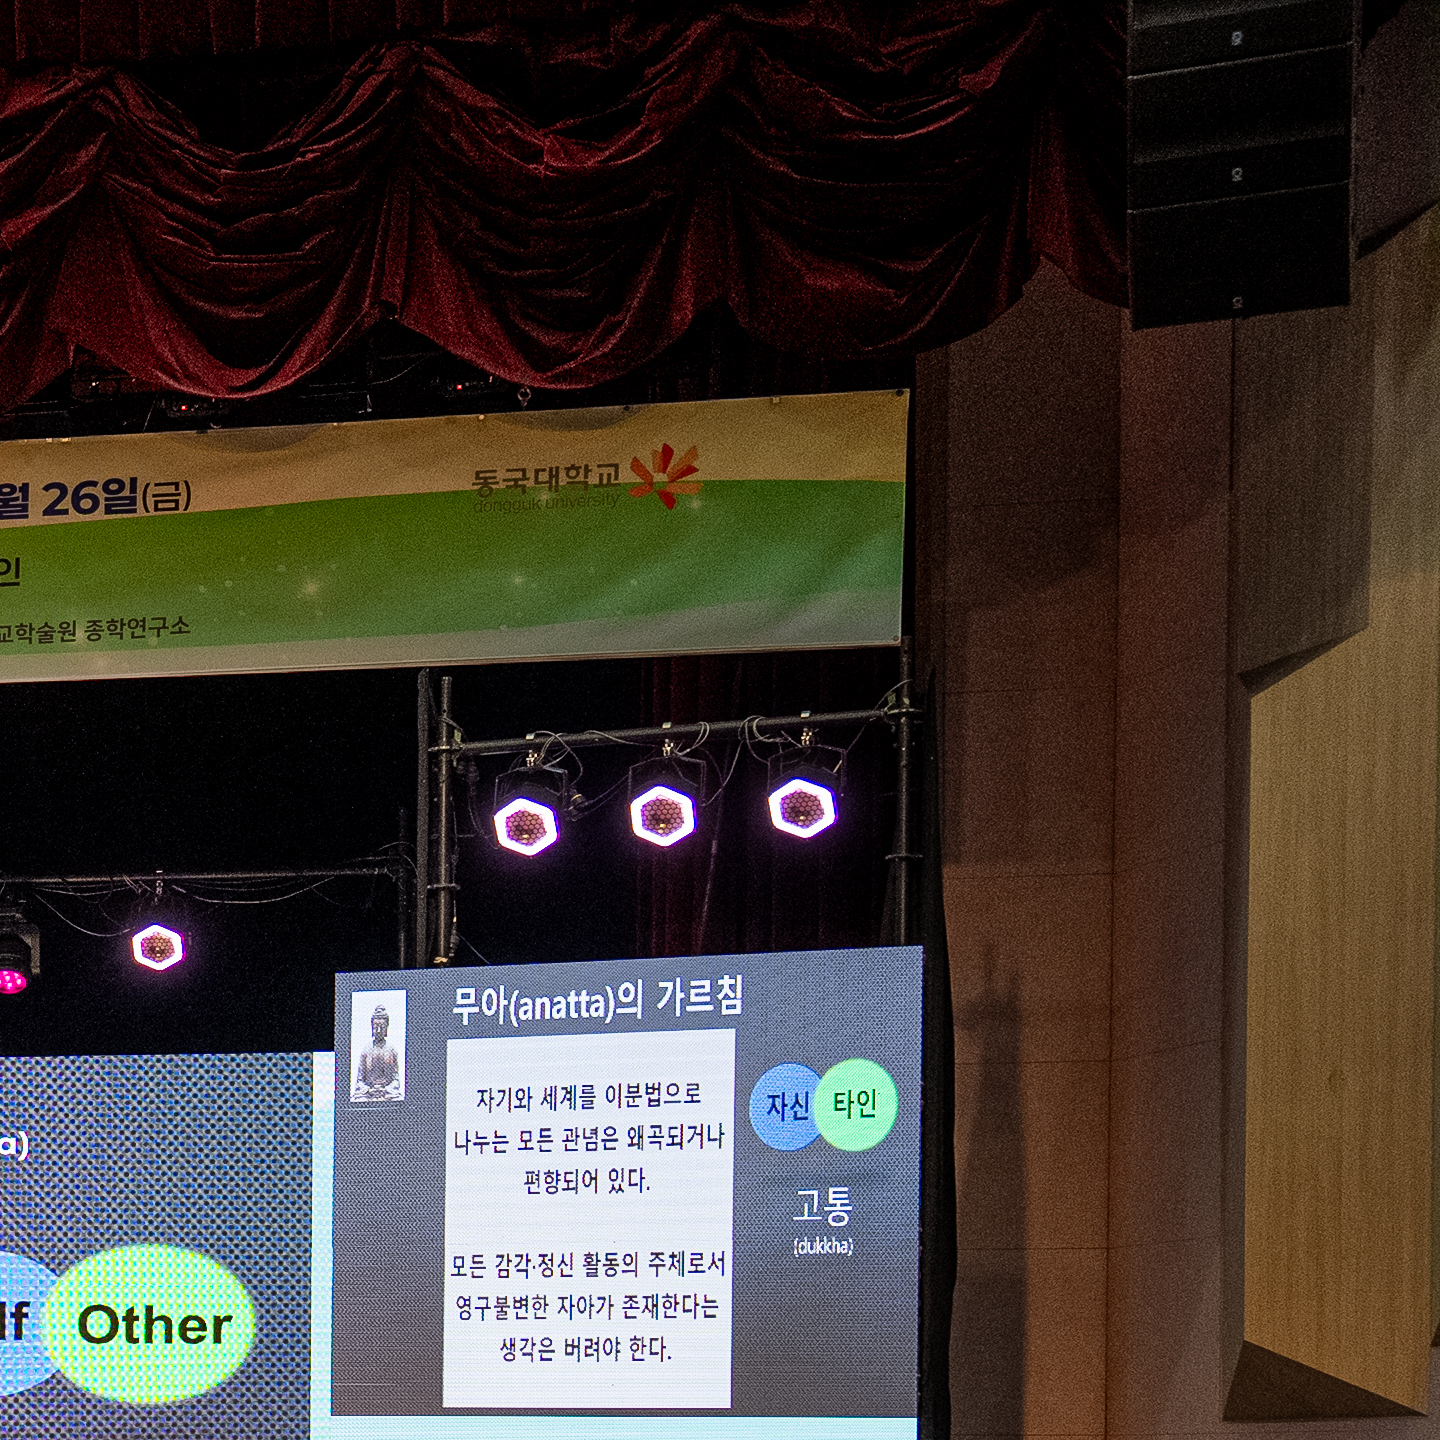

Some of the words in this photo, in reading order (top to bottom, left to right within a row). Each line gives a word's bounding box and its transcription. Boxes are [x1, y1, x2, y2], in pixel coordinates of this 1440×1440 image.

[472, 463, 620, 498] 동국대학교
[41, 476, 191, 517] 26일(금)
[84, 615, 191, 642] 종학연구소
[453, 979, 643, 1028] 무아(anatta)의
[657, 974, 742, 1017] 가르침
[477, 1086, 533, 1113] 자기와
[540, 1084, 596, 1111] 세계를
[606, 1082, 701, 1108] 이분법으로
[766, 1091, 809, 1122] 자신
[834, 1089, 876, 1119] 타인
[455, 1130, 509, 1155] 나누는
[517, 1128, 553, 1152] 모든
[562, 1126, 619, 1152] 관념은
[627, 1122, 725, 1151] 왜곡되거나
[524, 1168, 598, 1194] 편향되어
[608, 1167, 650, 1194] 있다.
[792, 1186, 853, 1227] 고통
[793, 1236, 854, 1257] (dukkha)
[451, 1254, 486, 1278] 모든
[495, 1252, 573, 1279] 감각·정신
[583, 1251, 638, 1278] 활동의
[649, 1251, 725, 1277] 주체로서
[456, 1295, 549, 1321] 영구불변한
[557, 1294, 614, 1320] 자아가
[622, 1293, 718, 1320] 존재한다는
[78, 1304, 233, 1344] Other
[500, 1337, 556, 1363] 생각은
[565, 1337, 620, 1362] 버려야
[629, 1336, 672, 1362] 한다.
